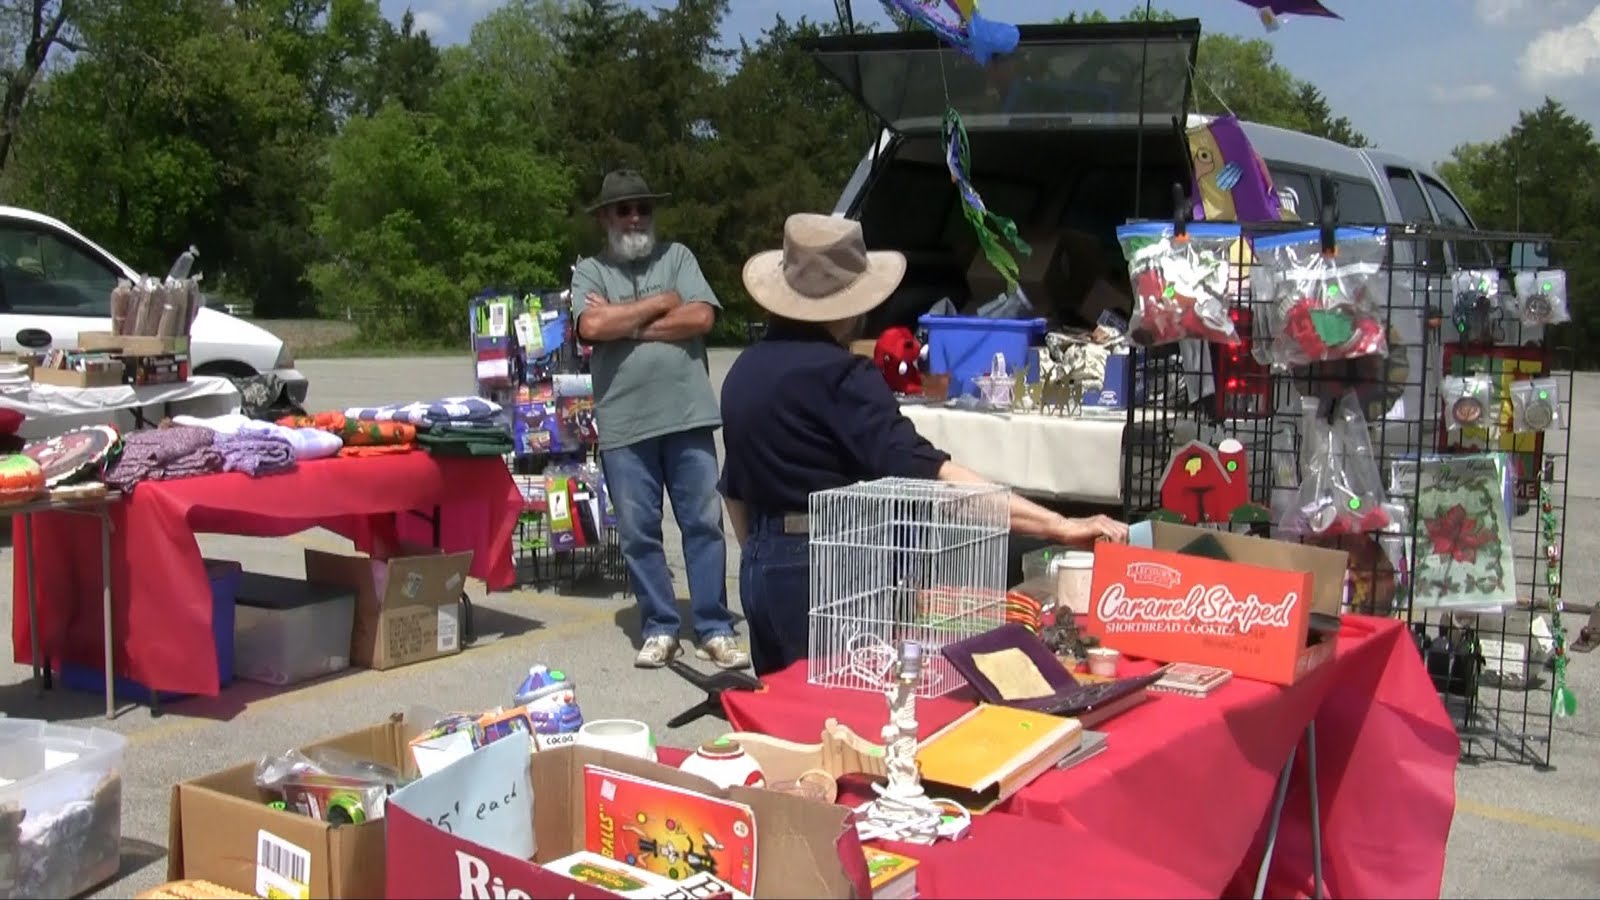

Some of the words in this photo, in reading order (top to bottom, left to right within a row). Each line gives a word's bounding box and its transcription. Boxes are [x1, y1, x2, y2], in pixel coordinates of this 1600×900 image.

[1097, 583, 1201, 622] Caramel
[1198, 584, 1298, 634] Striped
[1105, 621, 1181, 634] SHORTBREAD
[476, 780, 518, 820] each
